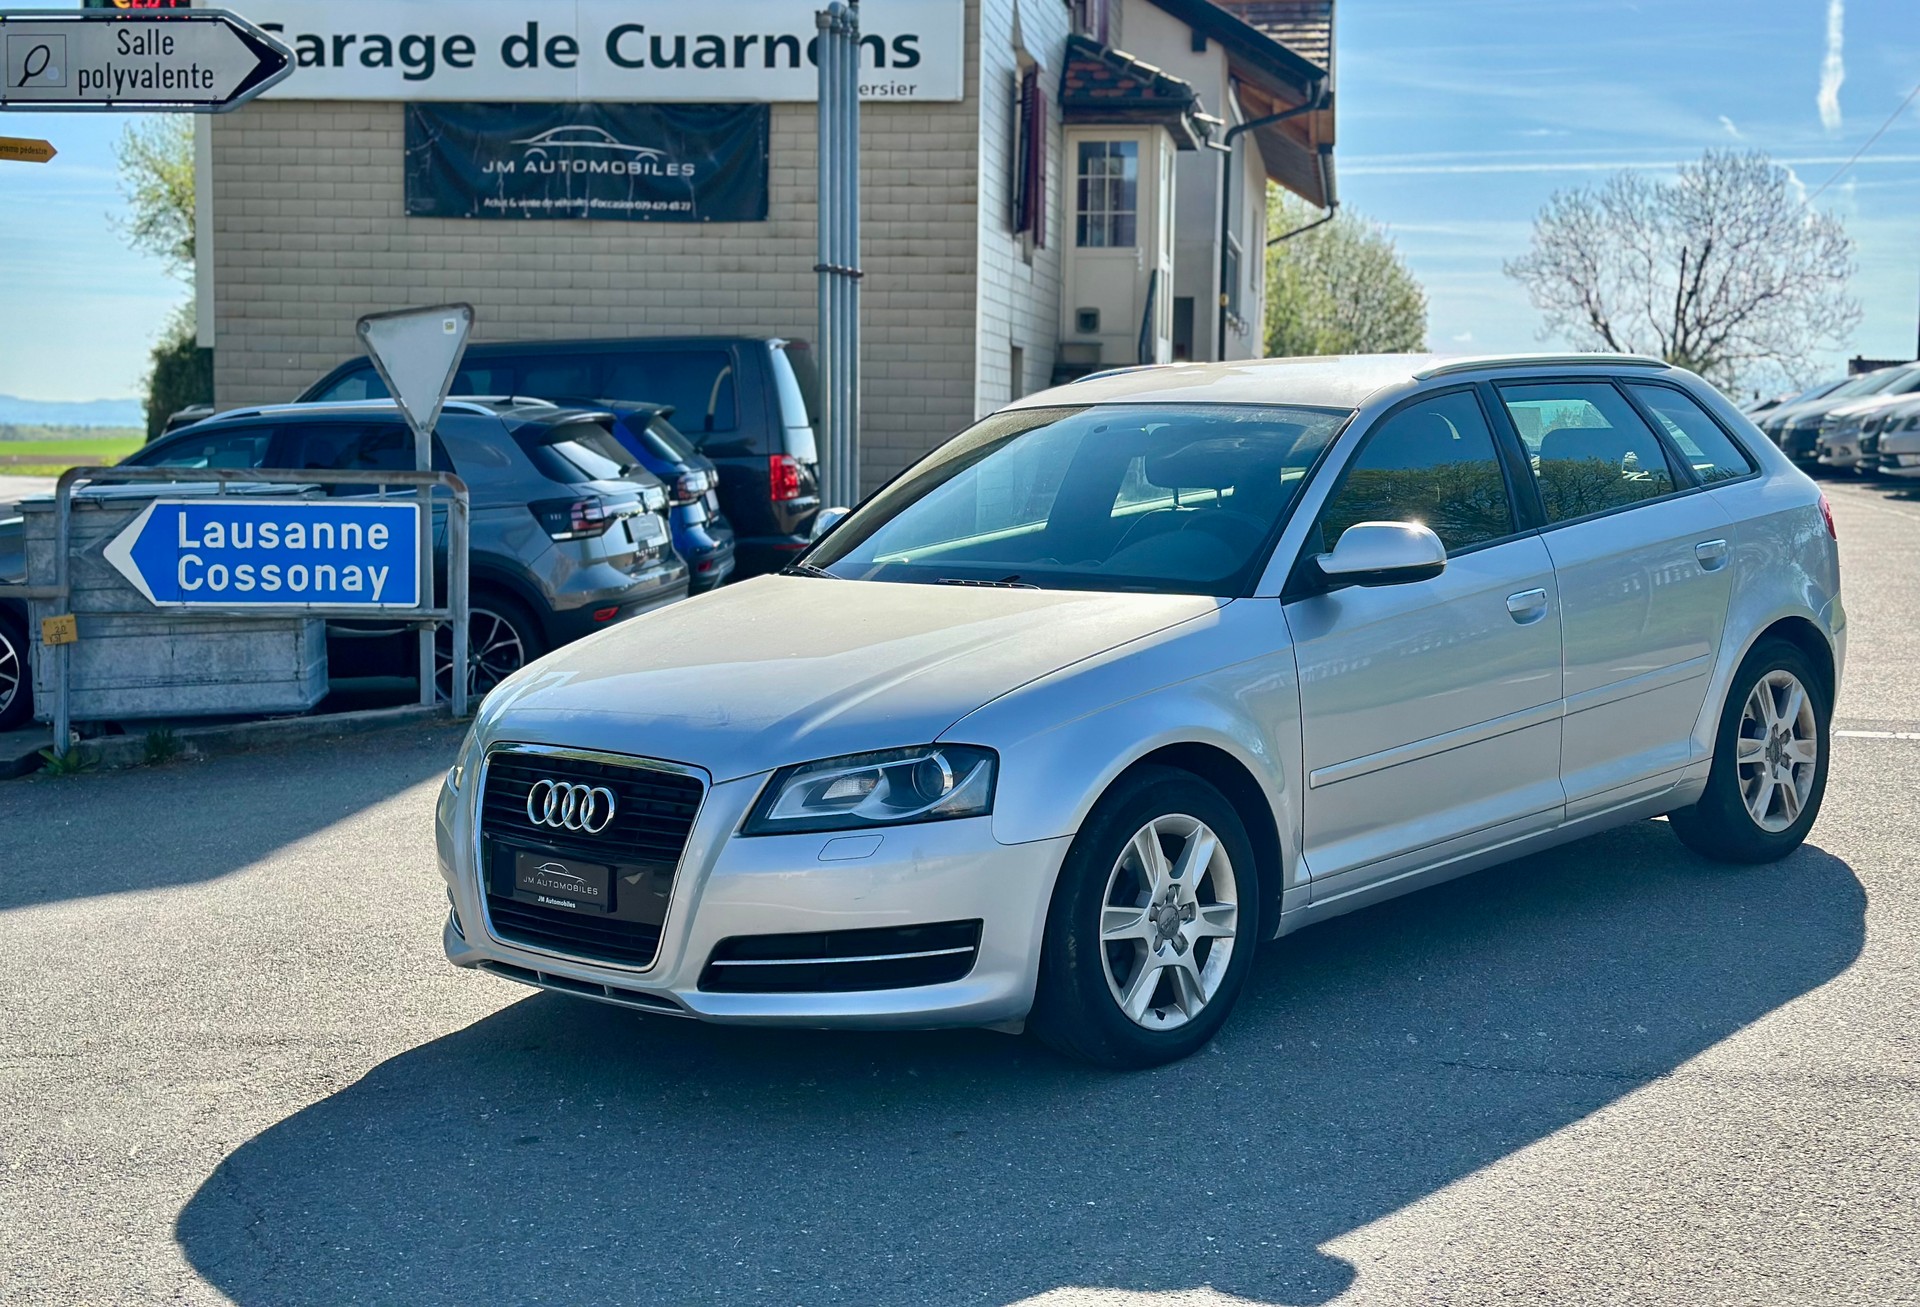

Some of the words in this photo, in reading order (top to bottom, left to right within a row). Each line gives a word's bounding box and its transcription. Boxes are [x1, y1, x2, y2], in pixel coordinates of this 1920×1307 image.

[117, 28, 174, 56] Salle
[258, 23, 476, 81] arage
[500, 21, 580, 68] de
[78, 62, 214, 96] polyvalente
[858, 80, 917, 96] ersier
[482, 160, 515, 174] JM
[523, 159, 696, 177] AUTOMOBILES
[178, 512, 389, 550] Lausanne
[178, 554, 389, 601] Cossonay
[523, 876, 535, 884] JM
[536, 879, 598, 896] AUTOMOBILES
[537, 895, 545, 903] JM
[546, 897, 576, 908] Automobiles
